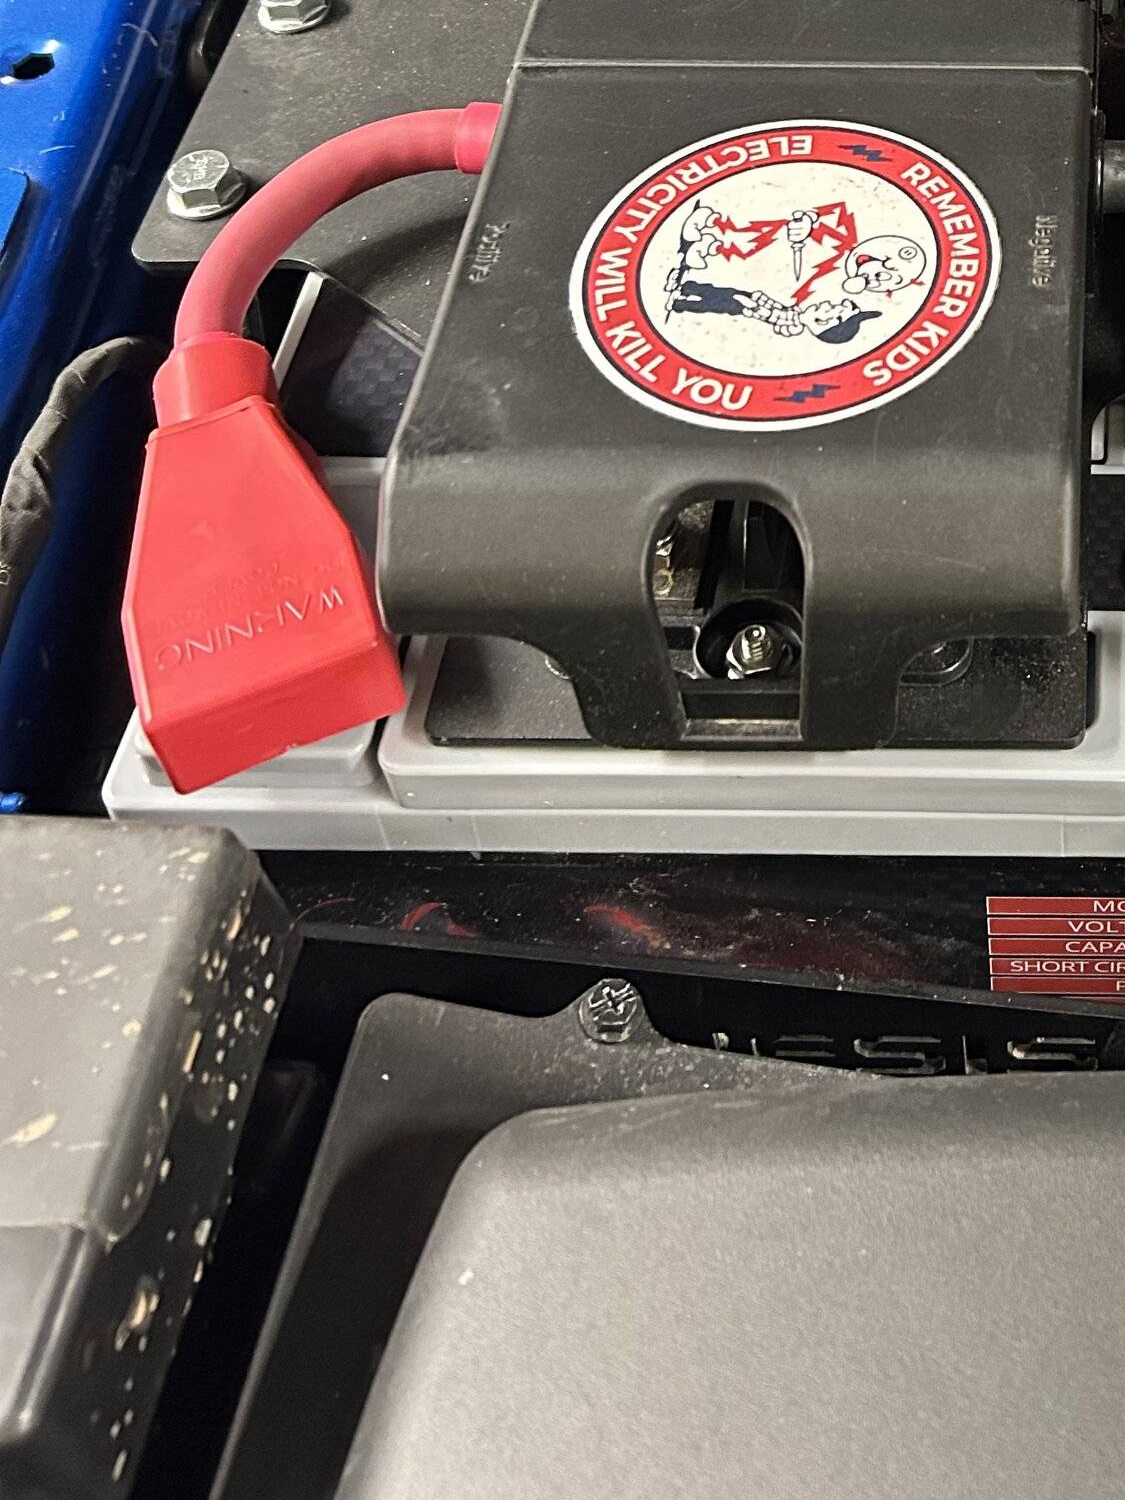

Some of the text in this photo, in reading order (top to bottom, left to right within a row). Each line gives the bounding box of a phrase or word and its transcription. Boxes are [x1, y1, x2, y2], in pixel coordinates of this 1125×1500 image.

[593, 133, 814, 412] ELECTRICITY WILL KILL YOU
[863, 161, 979, 389] REMEMBER KIDS
[154, 585, 345, 671] WARNING
[1010, 960, 1090, 973] SHORT
